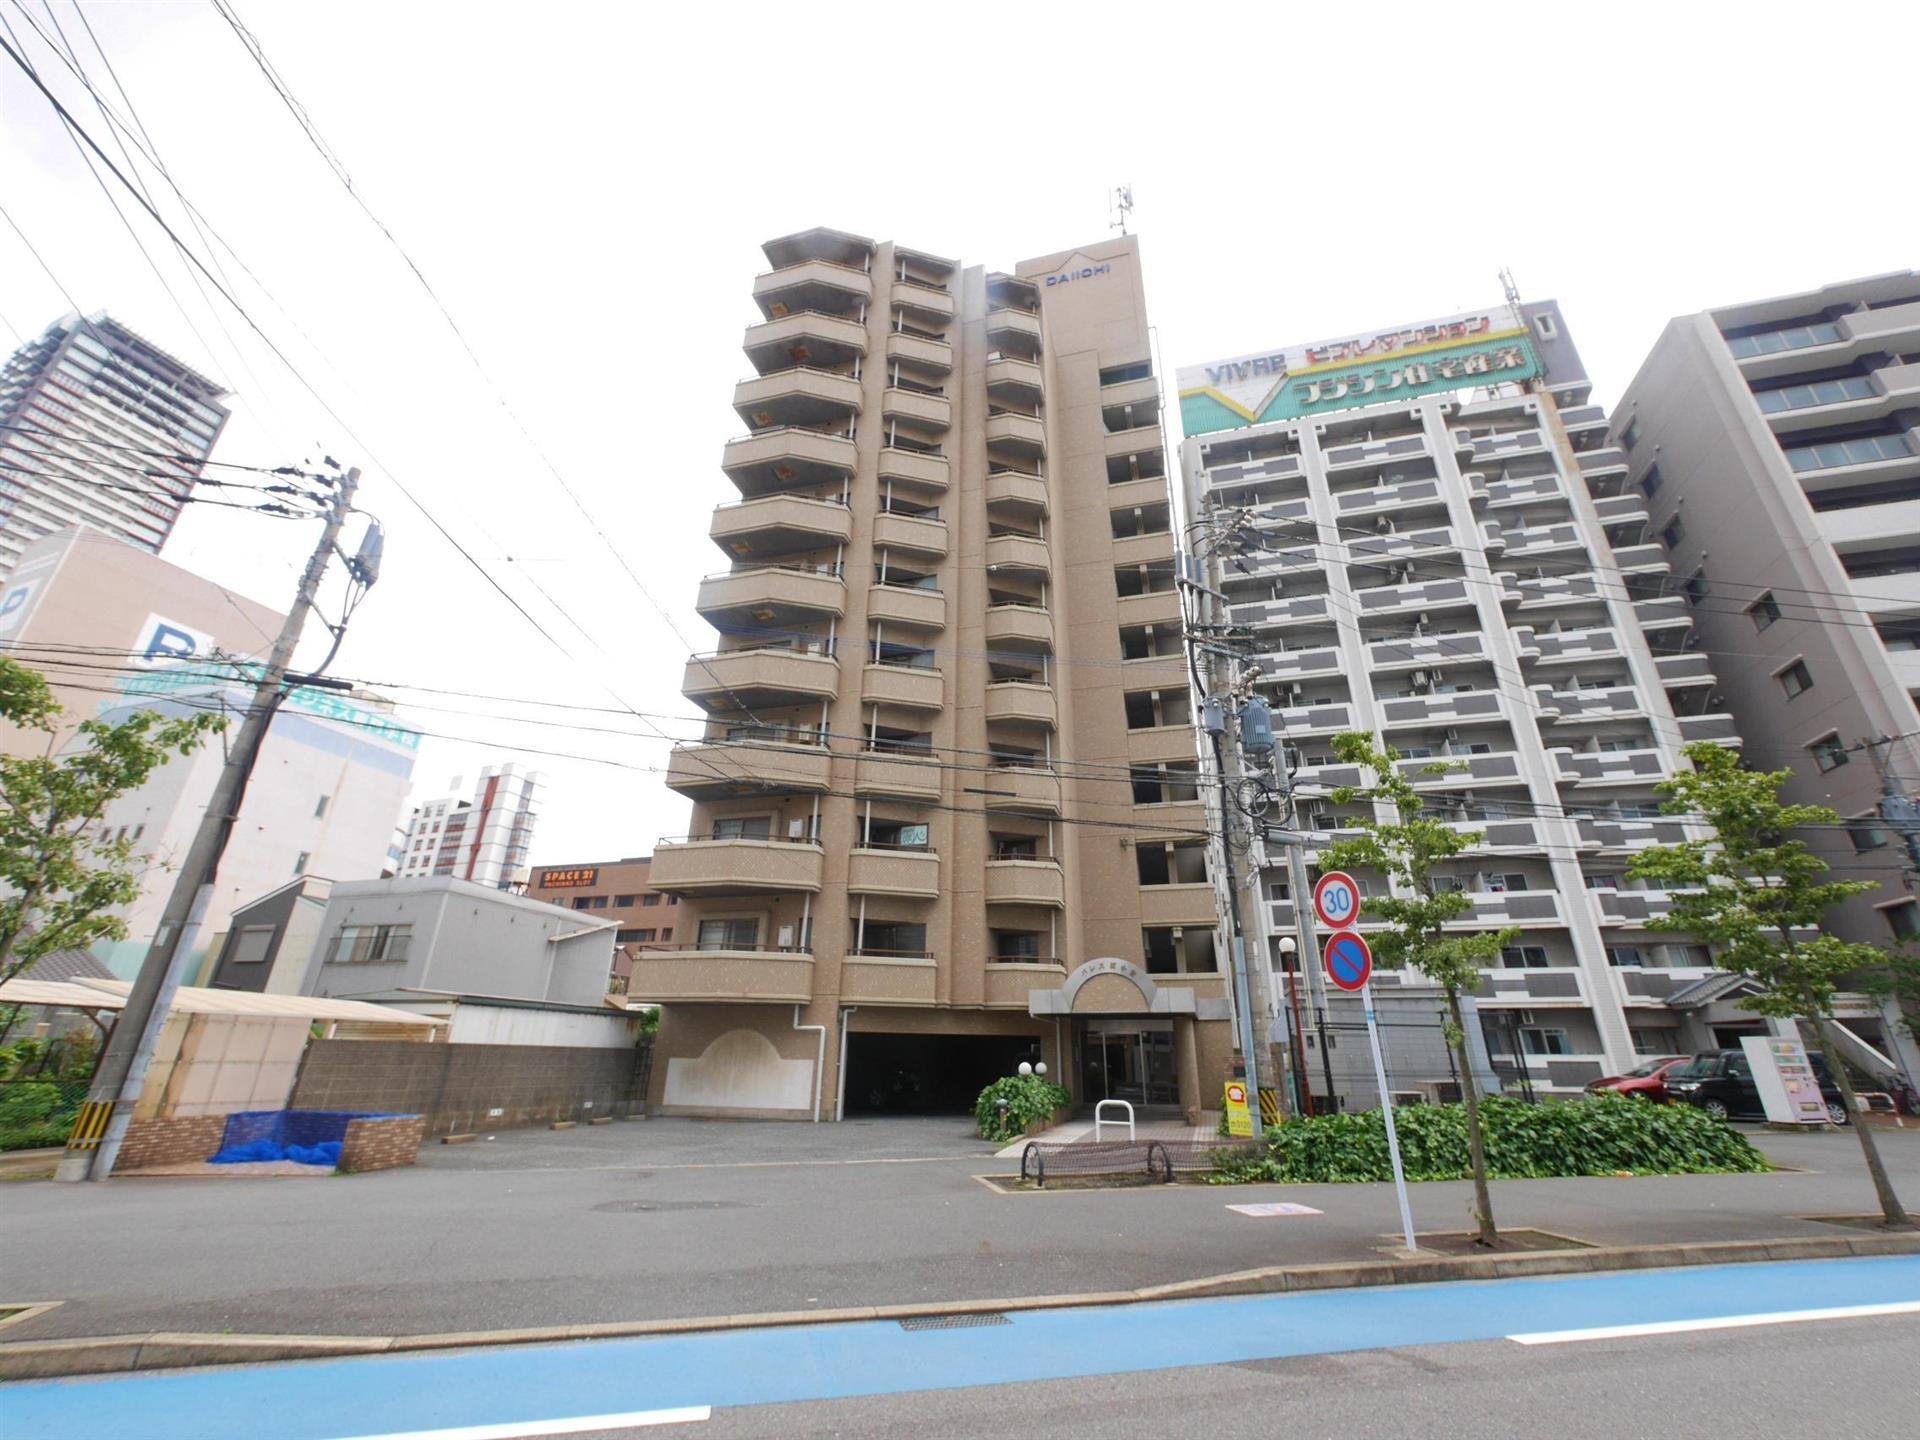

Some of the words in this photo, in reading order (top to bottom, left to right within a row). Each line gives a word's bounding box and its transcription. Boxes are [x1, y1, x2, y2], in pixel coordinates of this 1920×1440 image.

[1046, 264, 1110, 287] DAIICHI
[1305, 316, 1490, 364] ビブレマンション
[143, 623, 197, 662] P
[545, 870, 580, 881] SPACE
[1324, 887, 1350, 914] 30
